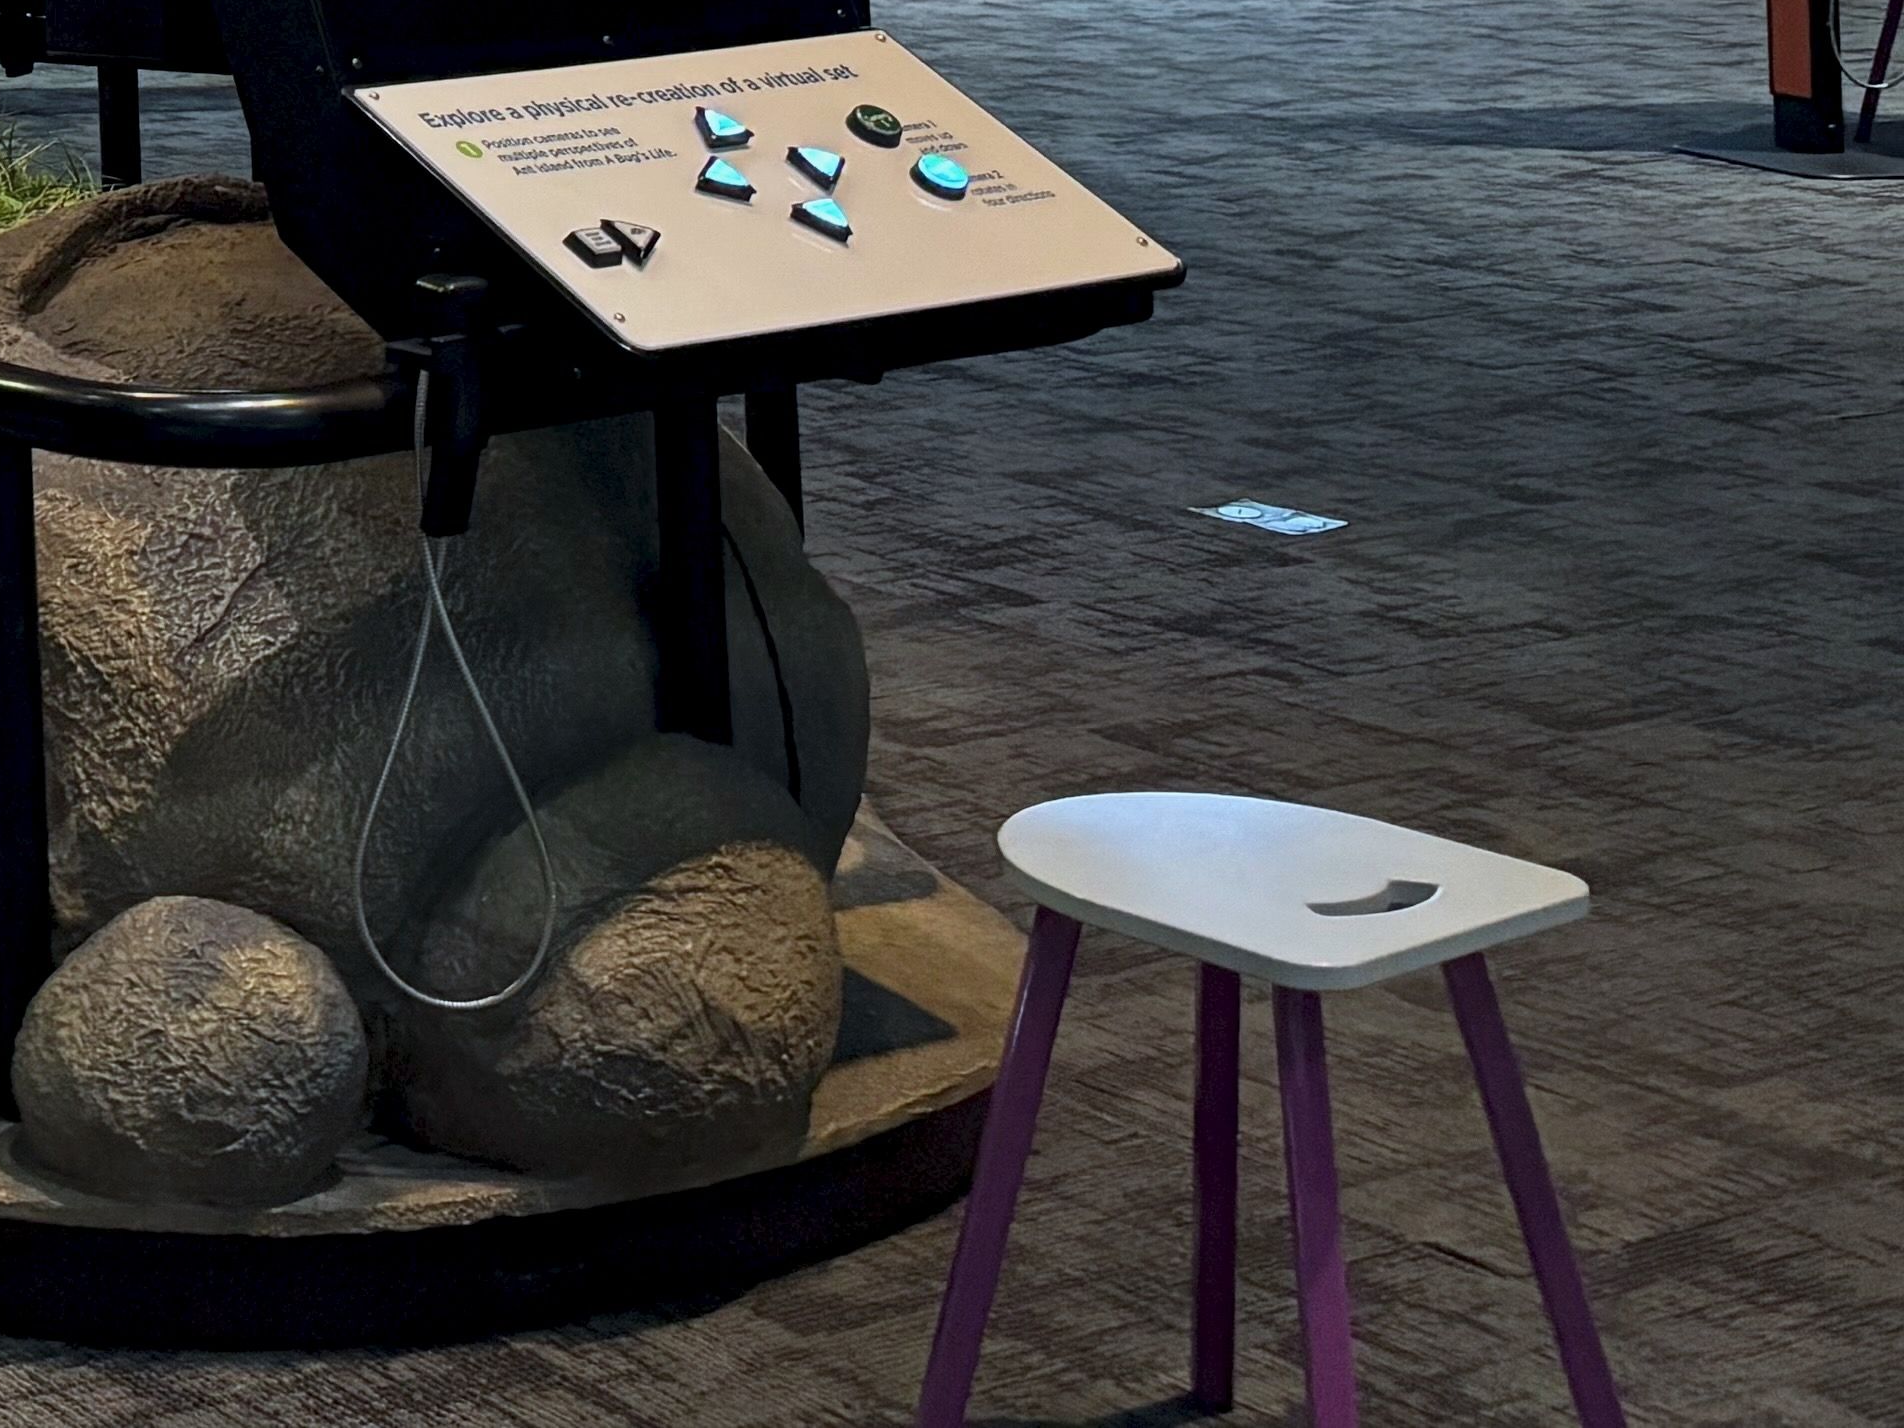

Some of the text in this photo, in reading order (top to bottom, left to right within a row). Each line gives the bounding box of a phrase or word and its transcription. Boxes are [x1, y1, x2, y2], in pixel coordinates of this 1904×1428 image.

[418, 64, 859, 129] Explore a physical re-creation of a virtual set
[481, 135, 534, 150] Position
[533, 130, 583, 145] cameras
[579, 128, 596, 139] to
[497, 147, 549, 163] multiple
[548, 139, 629, 159] perspectives
[573, 155, 604, 169] from
[604, 154, 617, 166] A
[616, 149, 650, 164] Bug's
